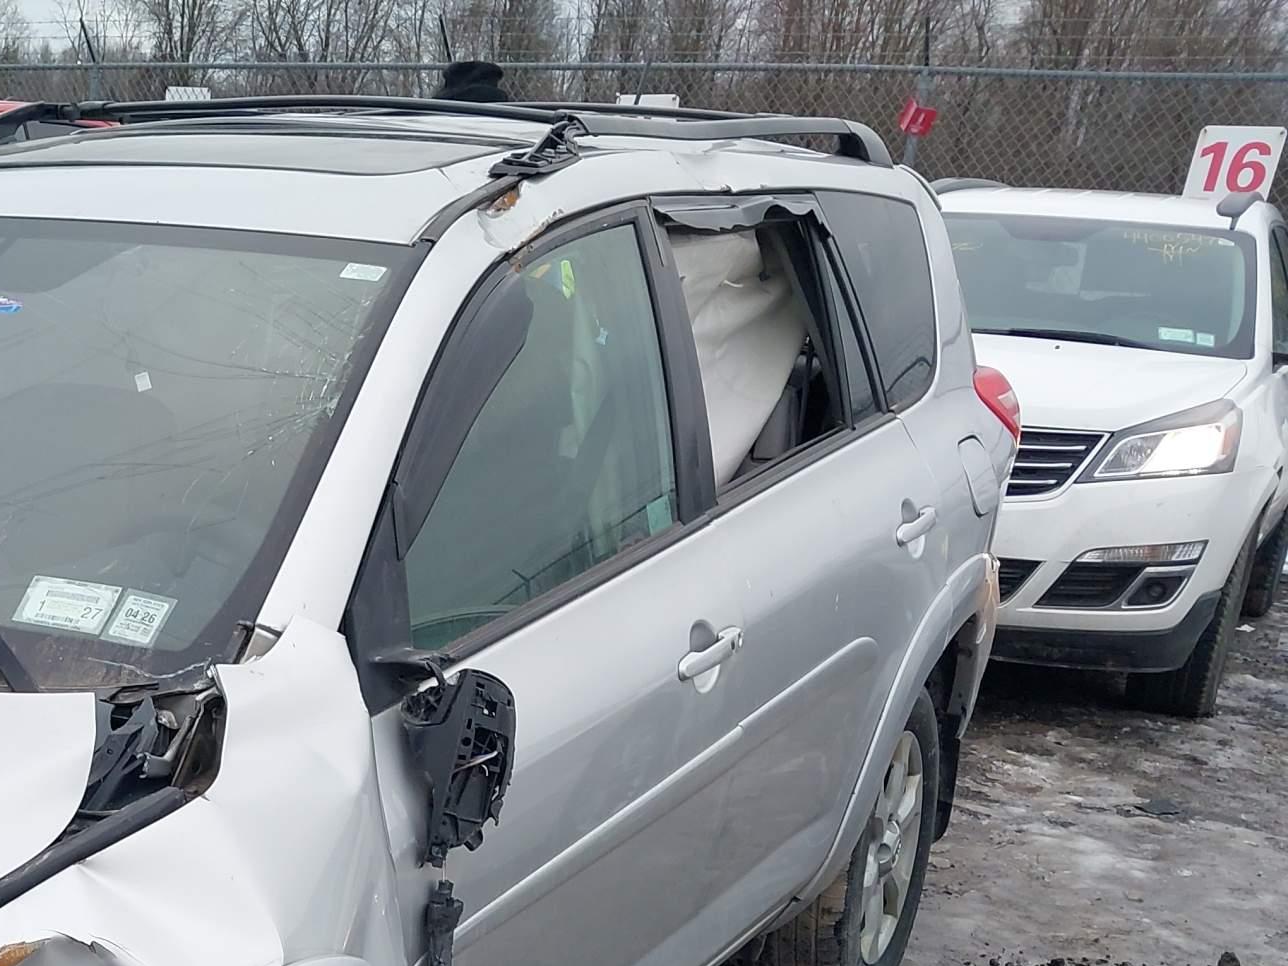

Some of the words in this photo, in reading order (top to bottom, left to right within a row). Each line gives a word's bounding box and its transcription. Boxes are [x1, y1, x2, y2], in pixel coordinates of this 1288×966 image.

[1199, 141, 1272, 193] 16
[80, 606, 104, 620] 27
[124, 607, 141, 619] 04
[142, 611, 158, 624] 26
